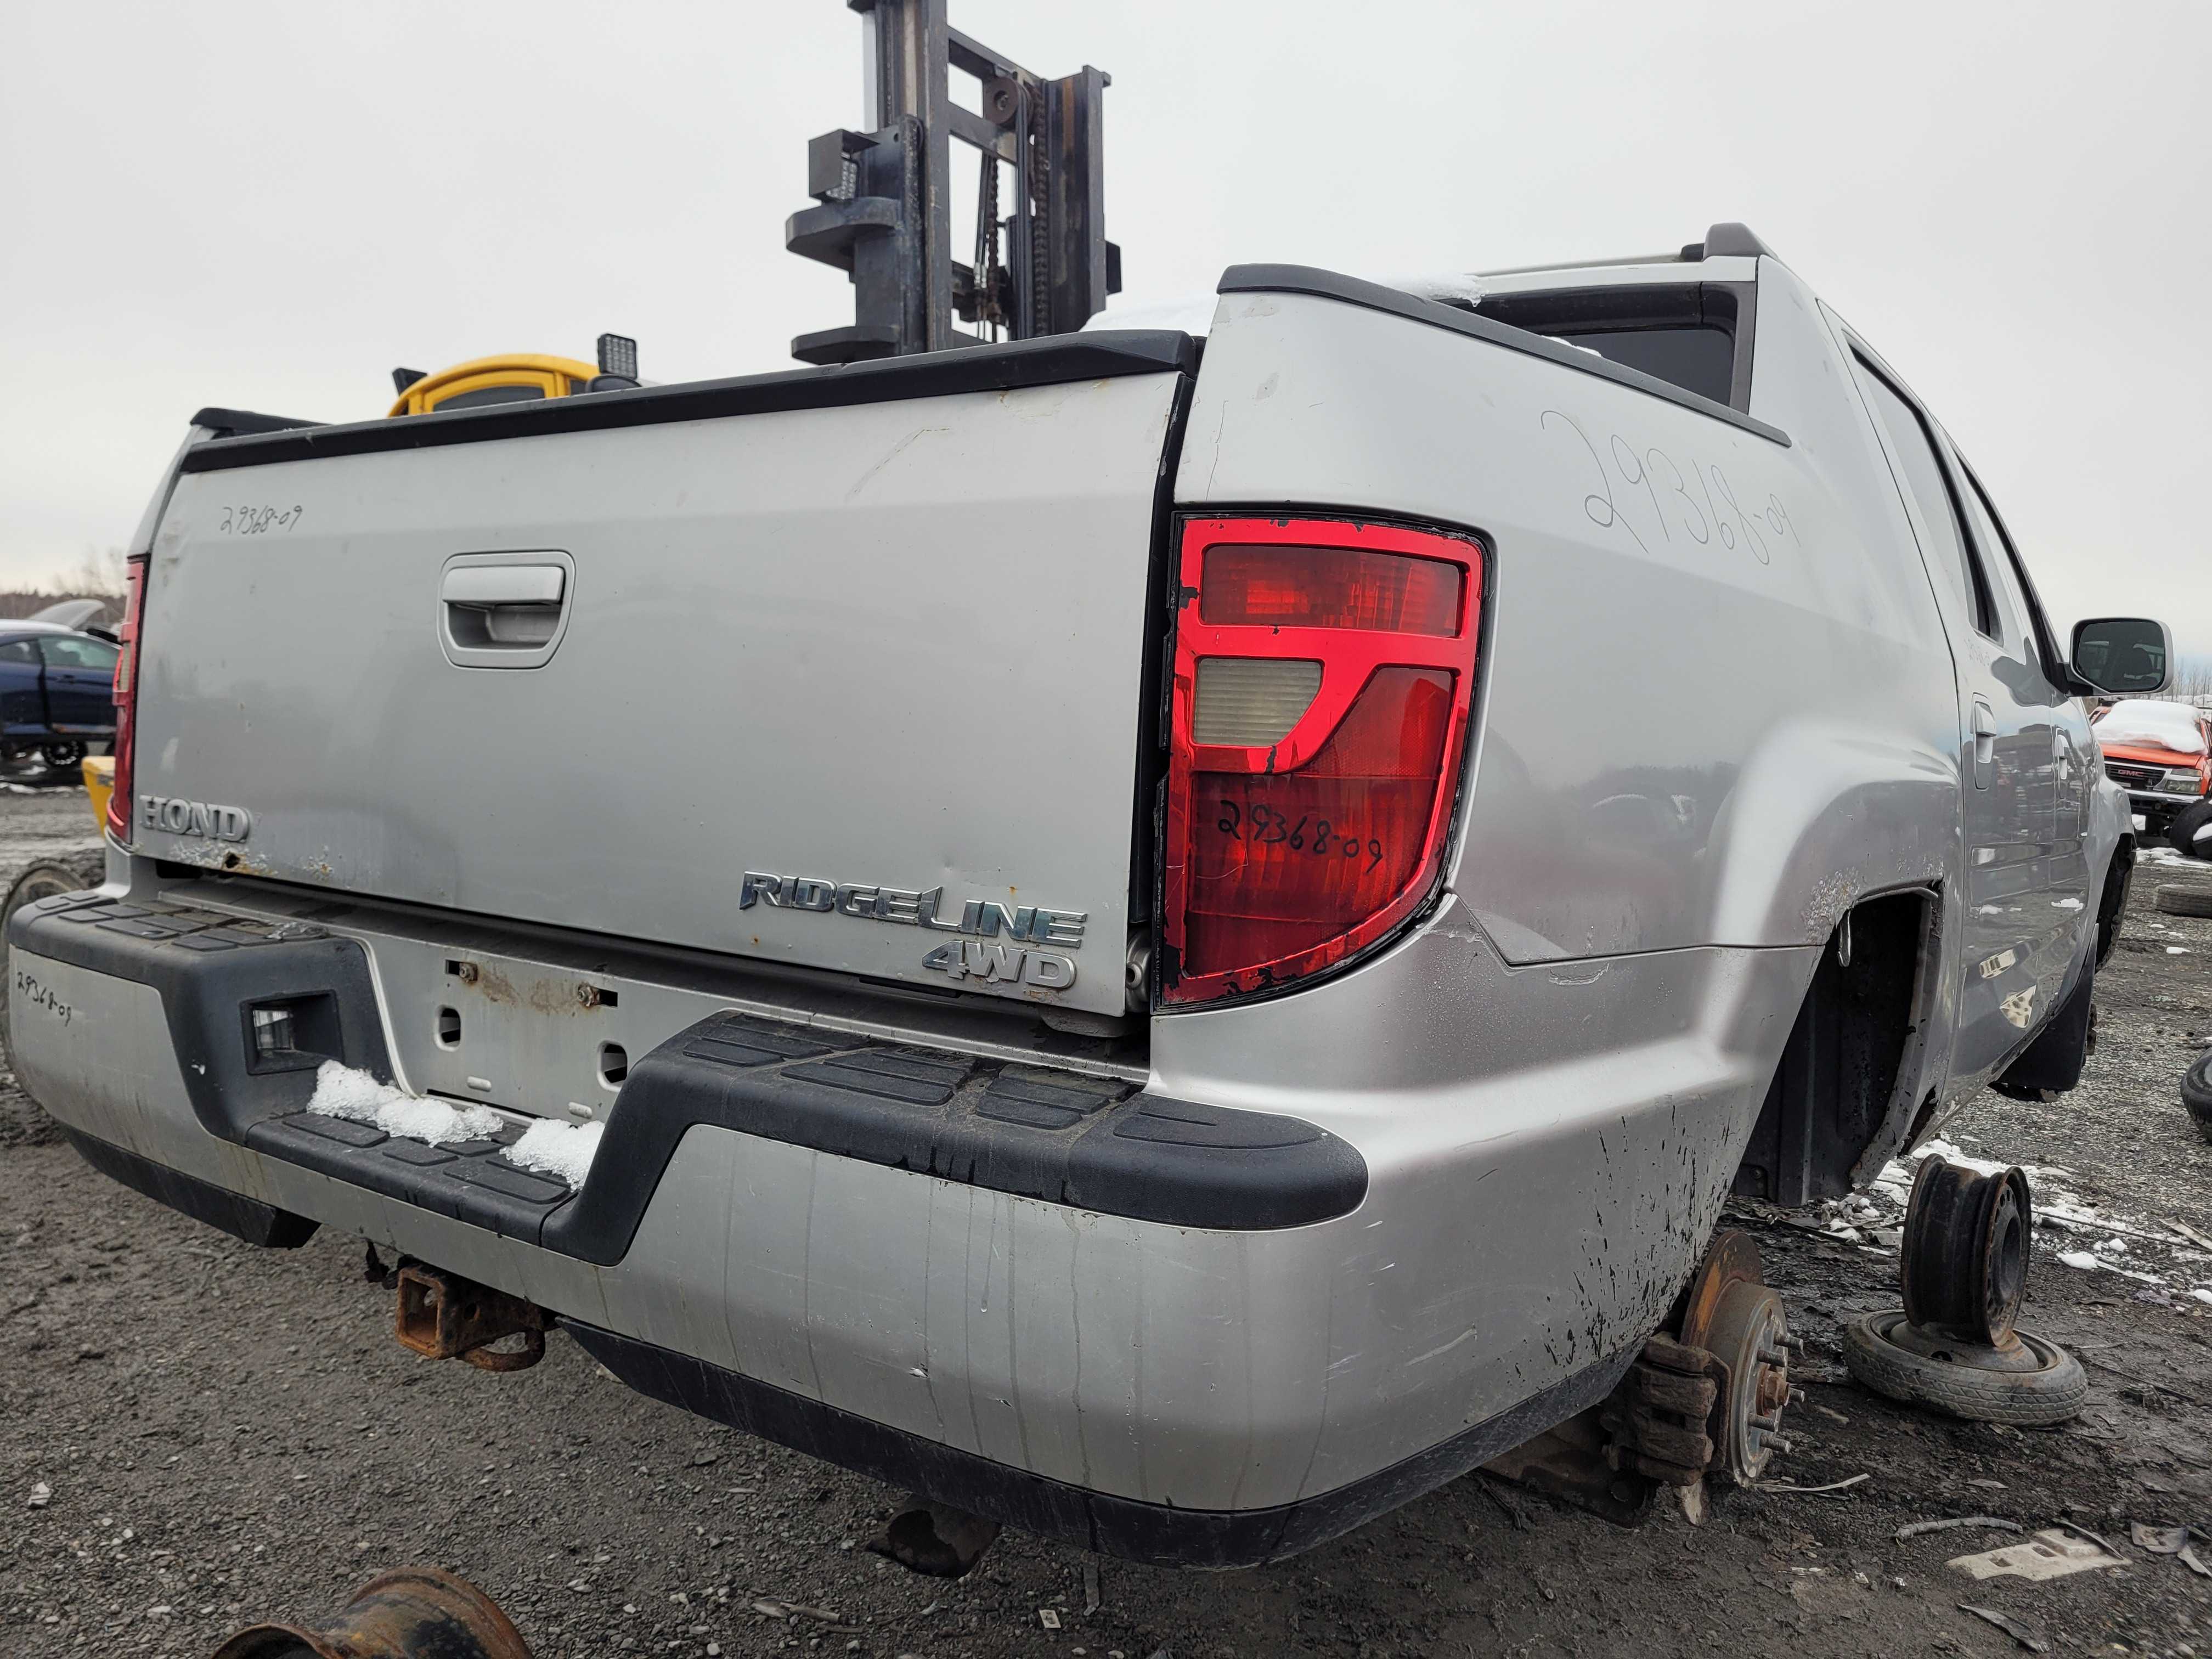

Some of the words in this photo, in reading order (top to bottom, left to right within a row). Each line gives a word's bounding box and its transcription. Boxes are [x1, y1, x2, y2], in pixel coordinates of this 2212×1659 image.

[220, 504, 303, 535] 29368-09
[2118, 769, 2145, 777] GMC
[739, 870, 1087, 947] RIDGELINE
[922, 940, 1076, 988] 4WD
[17, 972, 72, 1027] 29368-09
